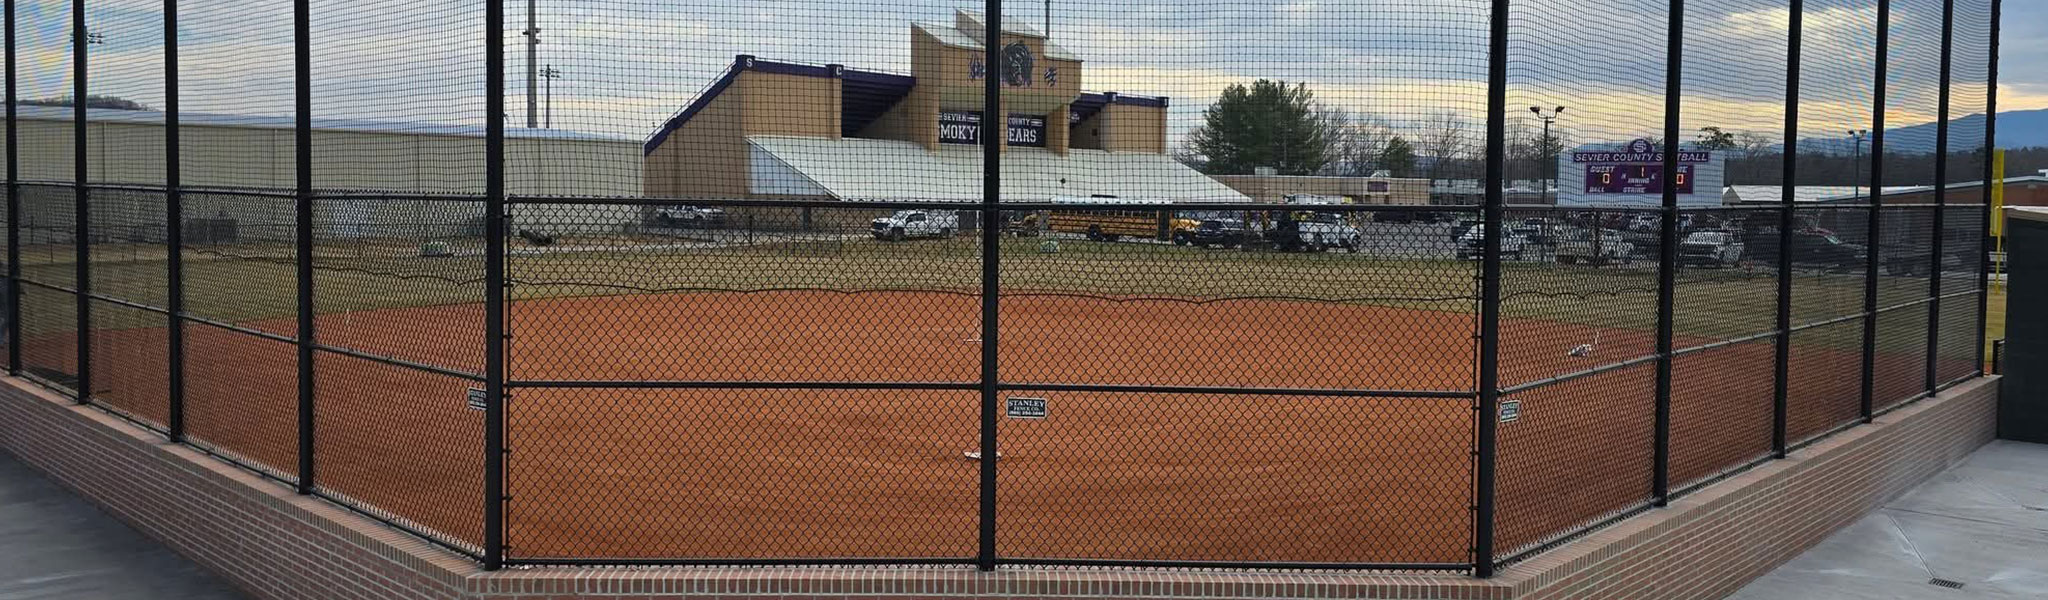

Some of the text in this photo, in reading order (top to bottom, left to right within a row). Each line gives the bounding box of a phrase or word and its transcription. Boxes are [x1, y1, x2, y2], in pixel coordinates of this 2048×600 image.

[746, 58, 753, 67] S
[836, 66, 842, 76] C
[943, 113, 967, 122] SEVIER
[1008, 117, 1030, 126] COUNTY
[939, 124, 976, 139] MOKY
[1009, 128, 1037, 142] EARS
[1575, 153, 1708, 162] SEVIER COUNTY STBALL
[1590, 165, 1615, 173] GUEST
[1602, 173, 1610, 184] 0
[1676, 173, 1684, 185] 0
